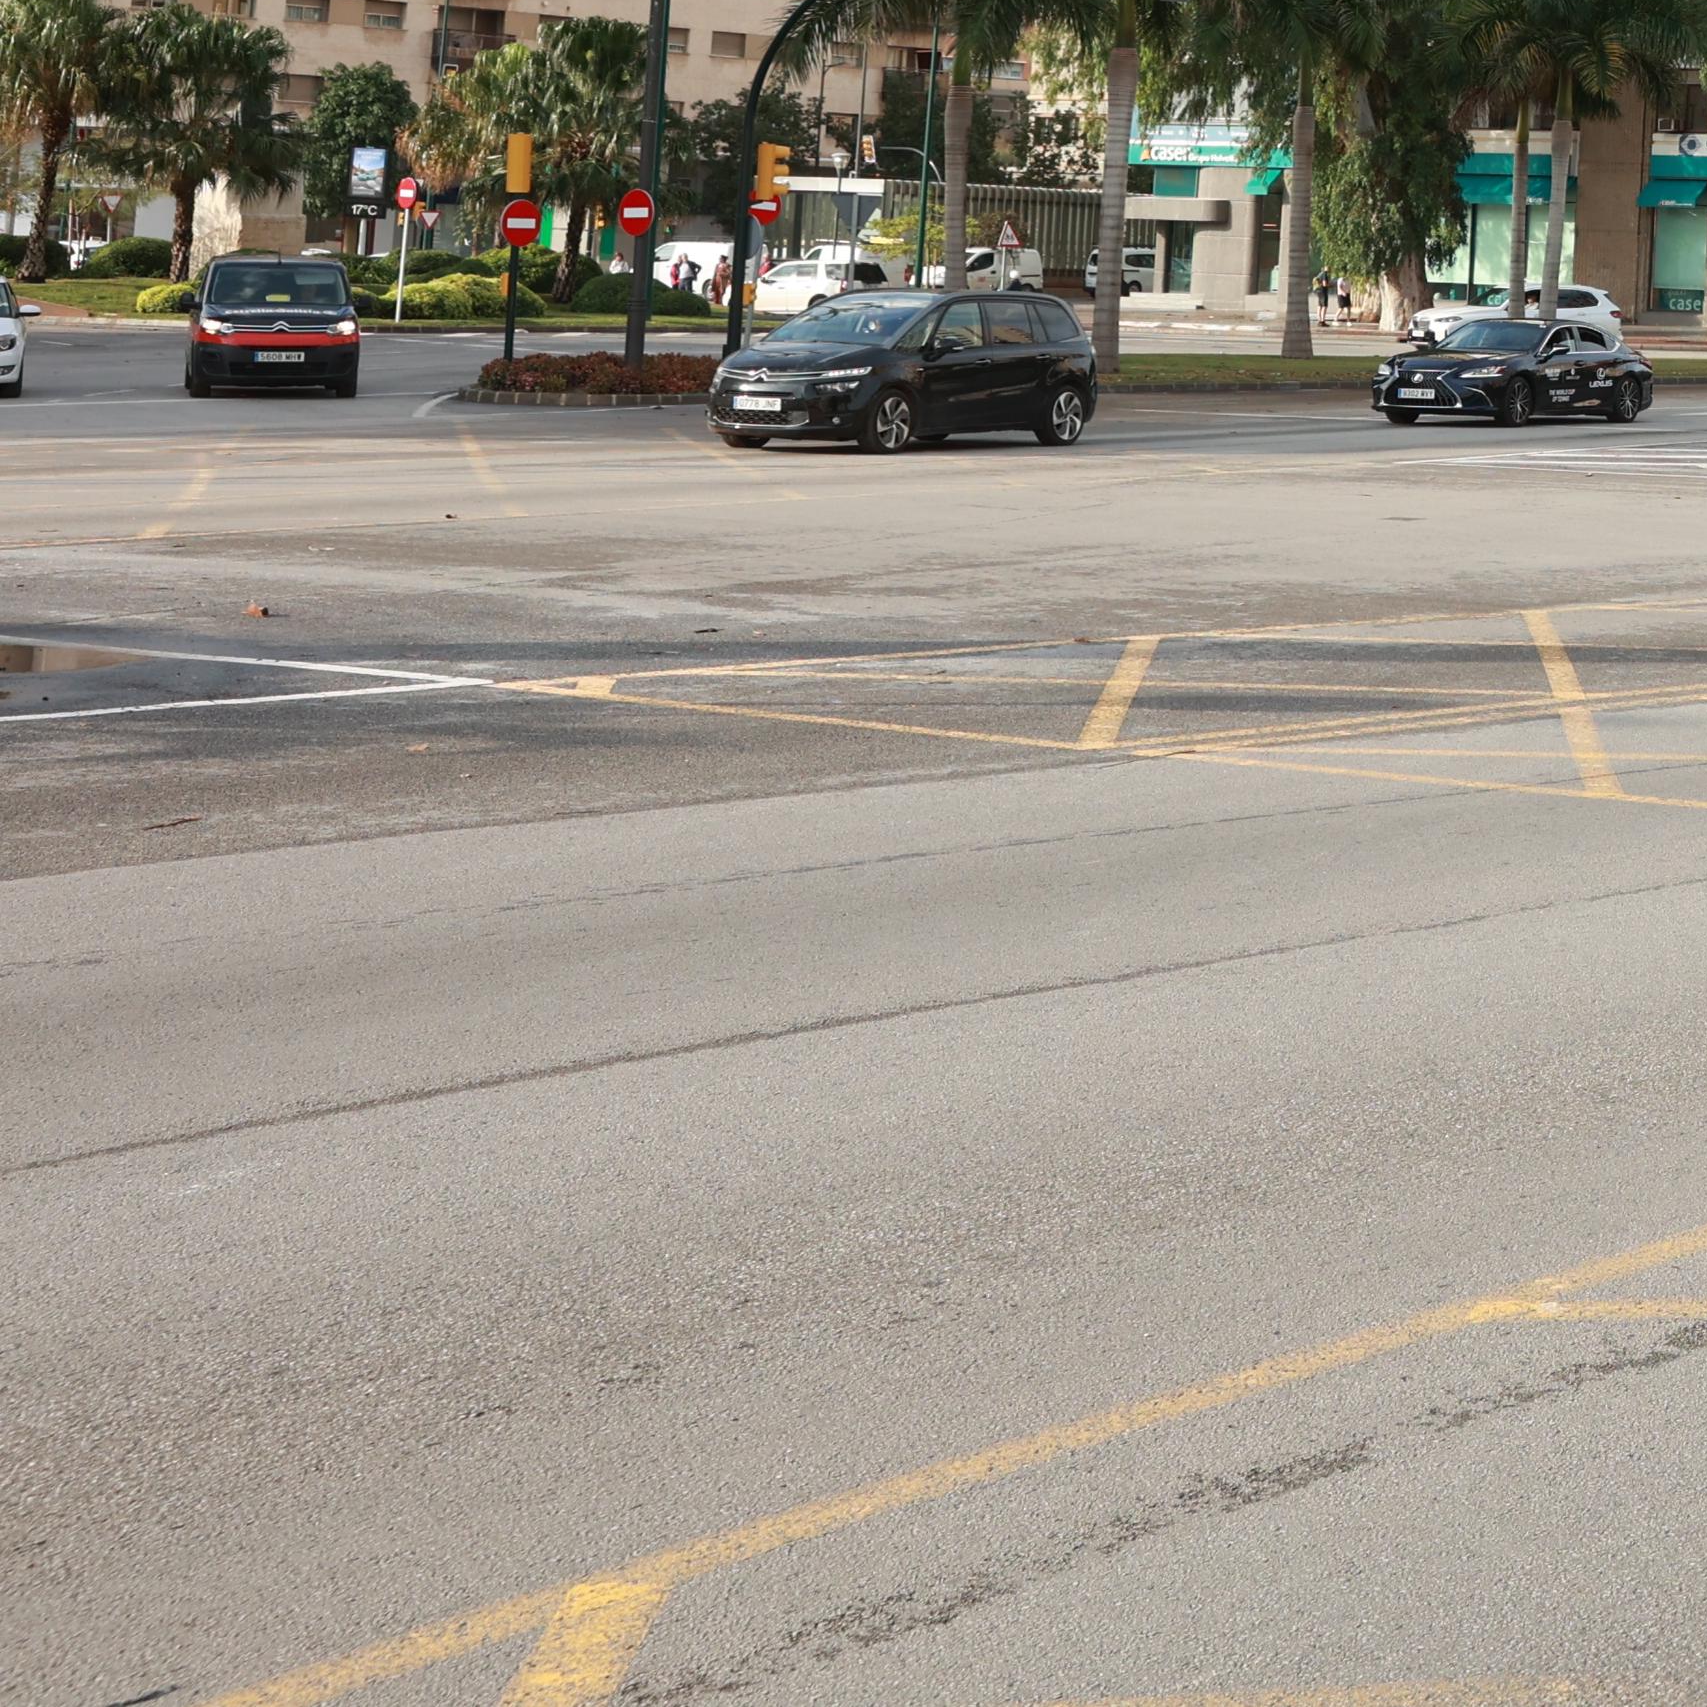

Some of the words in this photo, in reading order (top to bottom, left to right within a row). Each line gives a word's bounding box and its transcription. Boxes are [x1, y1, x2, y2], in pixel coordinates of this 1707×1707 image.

[1151, 146, 1190, 161] caser
[351, 204, 378, 216] 17°C
[1669, 298, 1702, 311] case
[260, 351, 283, 361] 5608
[1589, 379, 1613, 389] LEXUS
